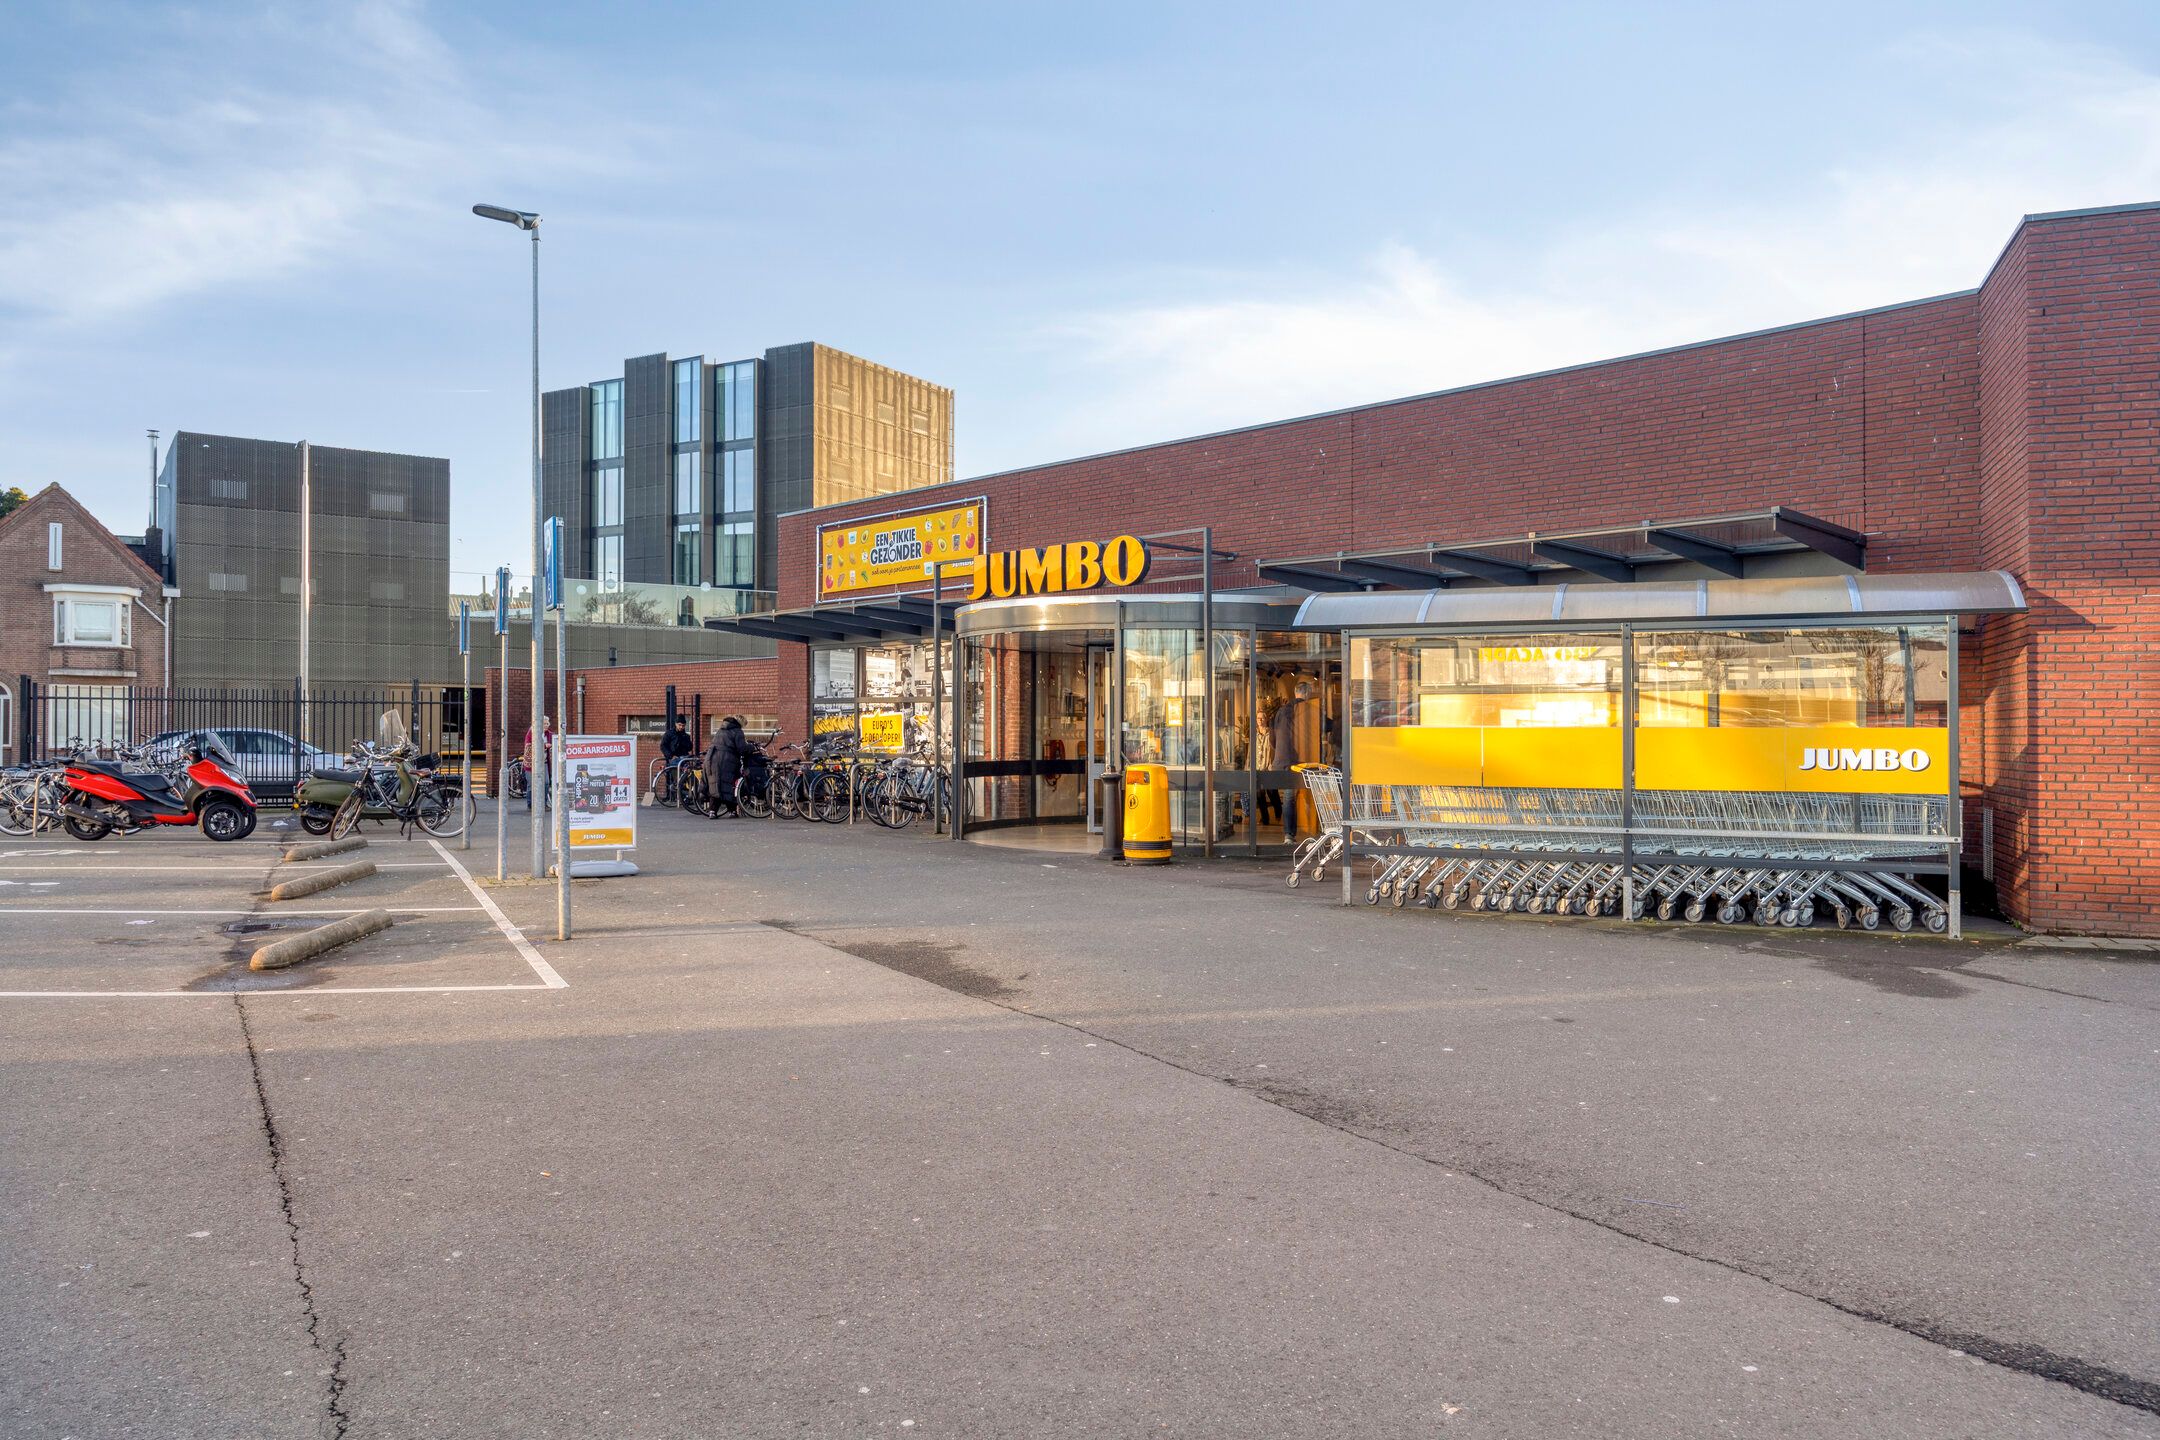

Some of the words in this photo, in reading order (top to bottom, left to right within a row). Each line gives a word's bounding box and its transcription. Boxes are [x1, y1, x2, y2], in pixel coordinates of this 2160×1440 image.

[876, 533, 889, 547] EEN
[891, 528, 916, 544] TIKKIE
[870, 542, 922, 565] GEZONDER
[967, 535, 1151, 601] JUMBO
[872, 719, 894, 730] EURO'S
[864, 732, 901, 743] GOEDOPER!
[566, 744, 627, 756] OORJAARSDEALS
[1799, 747, 1931, 772] JUMBO
